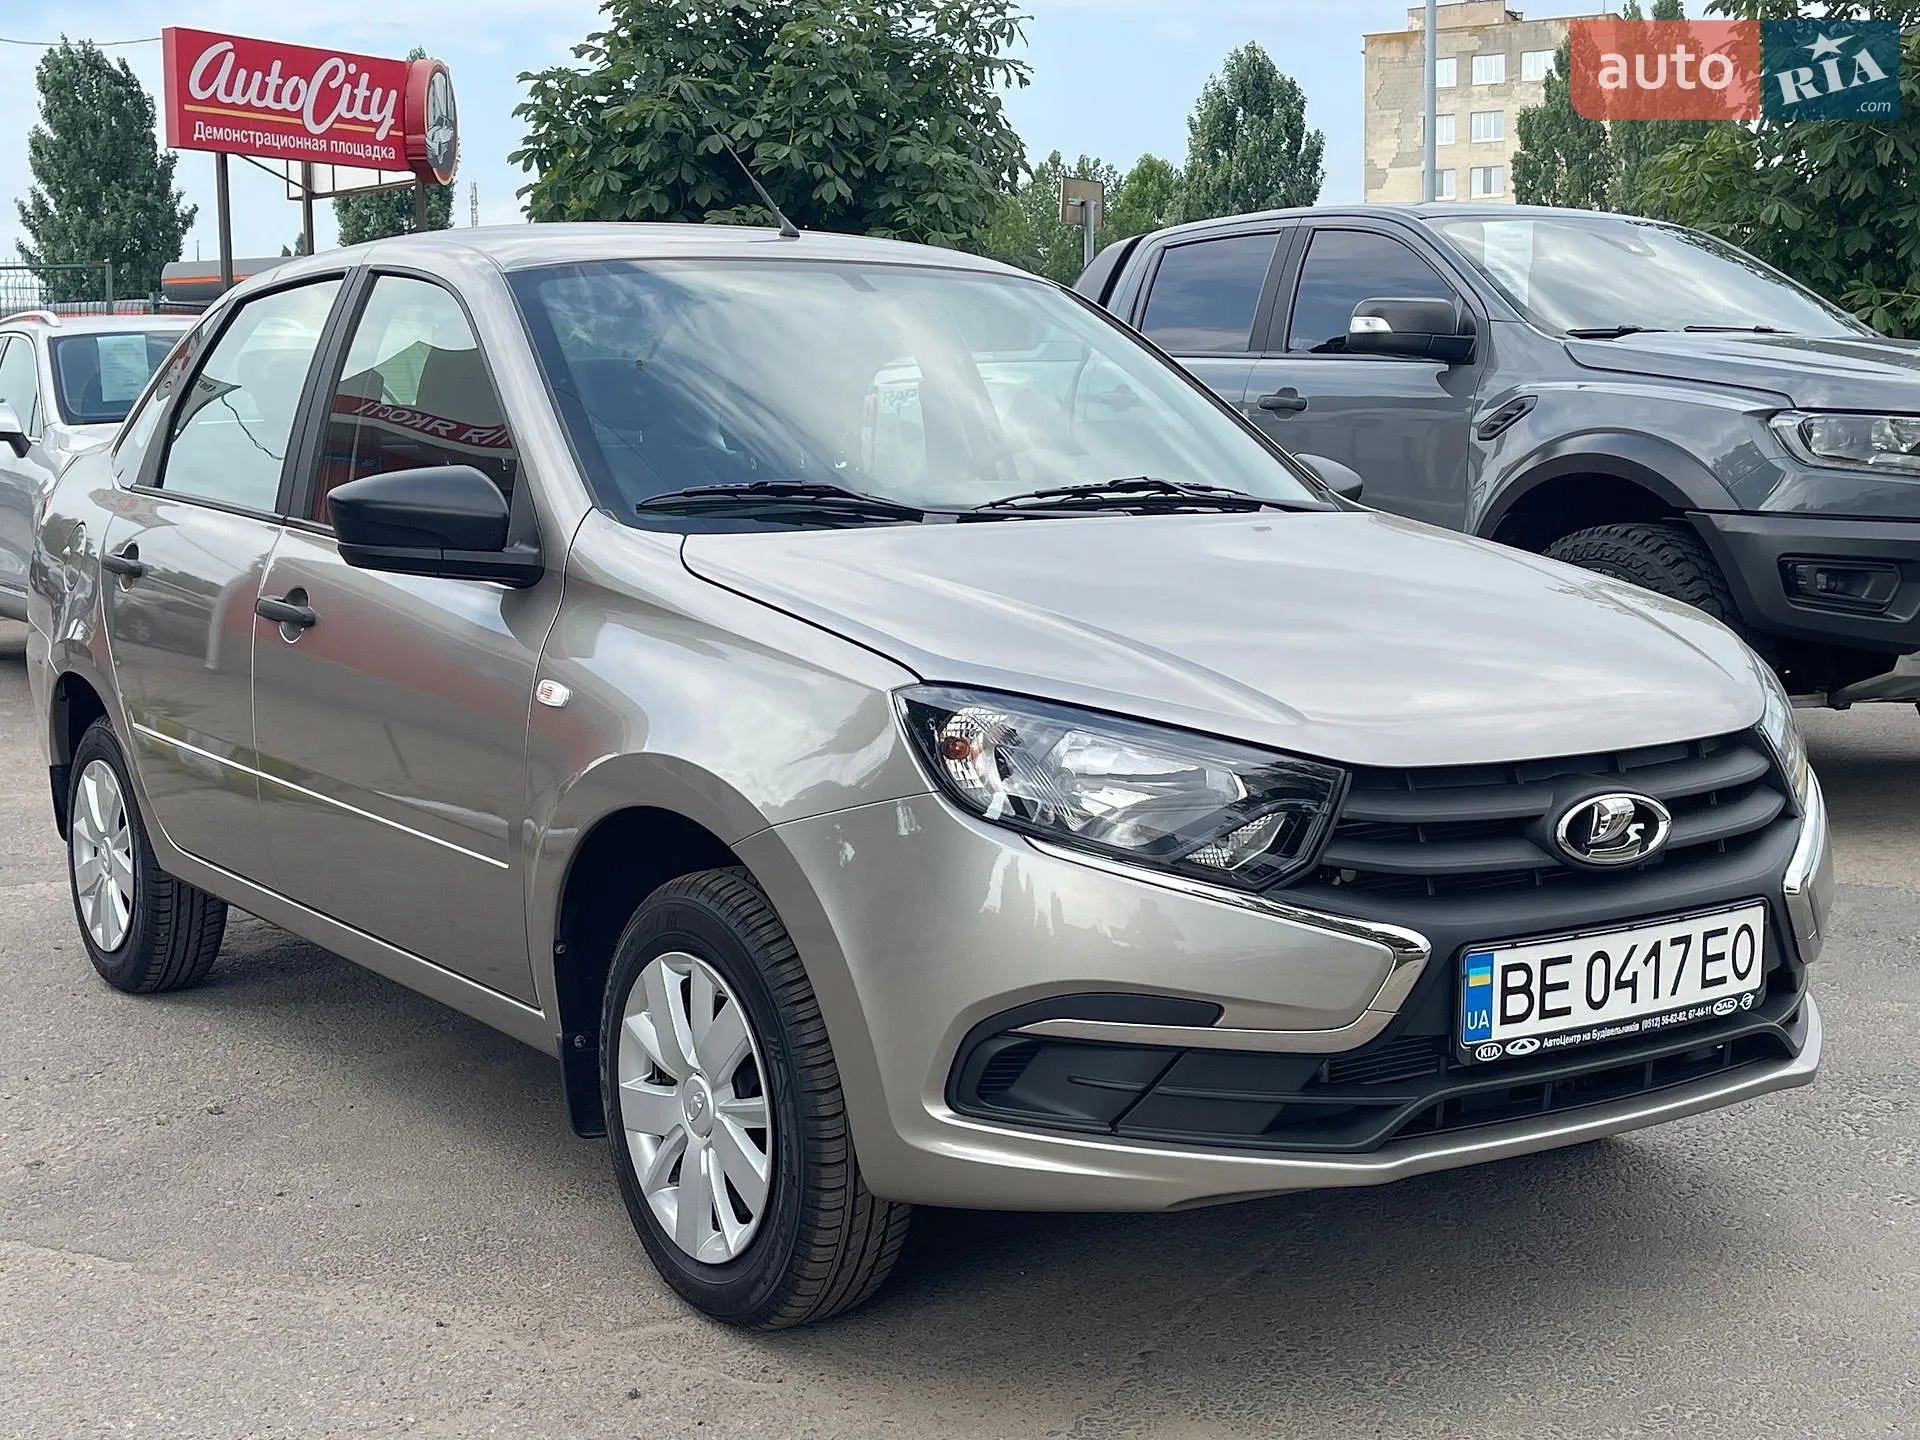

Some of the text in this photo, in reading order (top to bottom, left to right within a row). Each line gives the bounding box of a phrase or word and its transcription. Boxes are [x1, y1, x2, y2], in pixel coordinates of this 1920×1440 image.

[188, 41, 397, 142] AutoCity
[193, 121, 396, 162] Демонстрационная площадка
[1500, 954, 1573, 1027] BE
[1585, 933, 1694, 1011] 0417
[1467, 1009, 1490, 1031] UA
[1543, 1033, 1582, 1048] АвтоЦентр
[1582, 1032, 1591, 1041] на
[1641, 1016, 1661, 1032] (0512)
[1478, 1045, 1500, 1059] KIA
